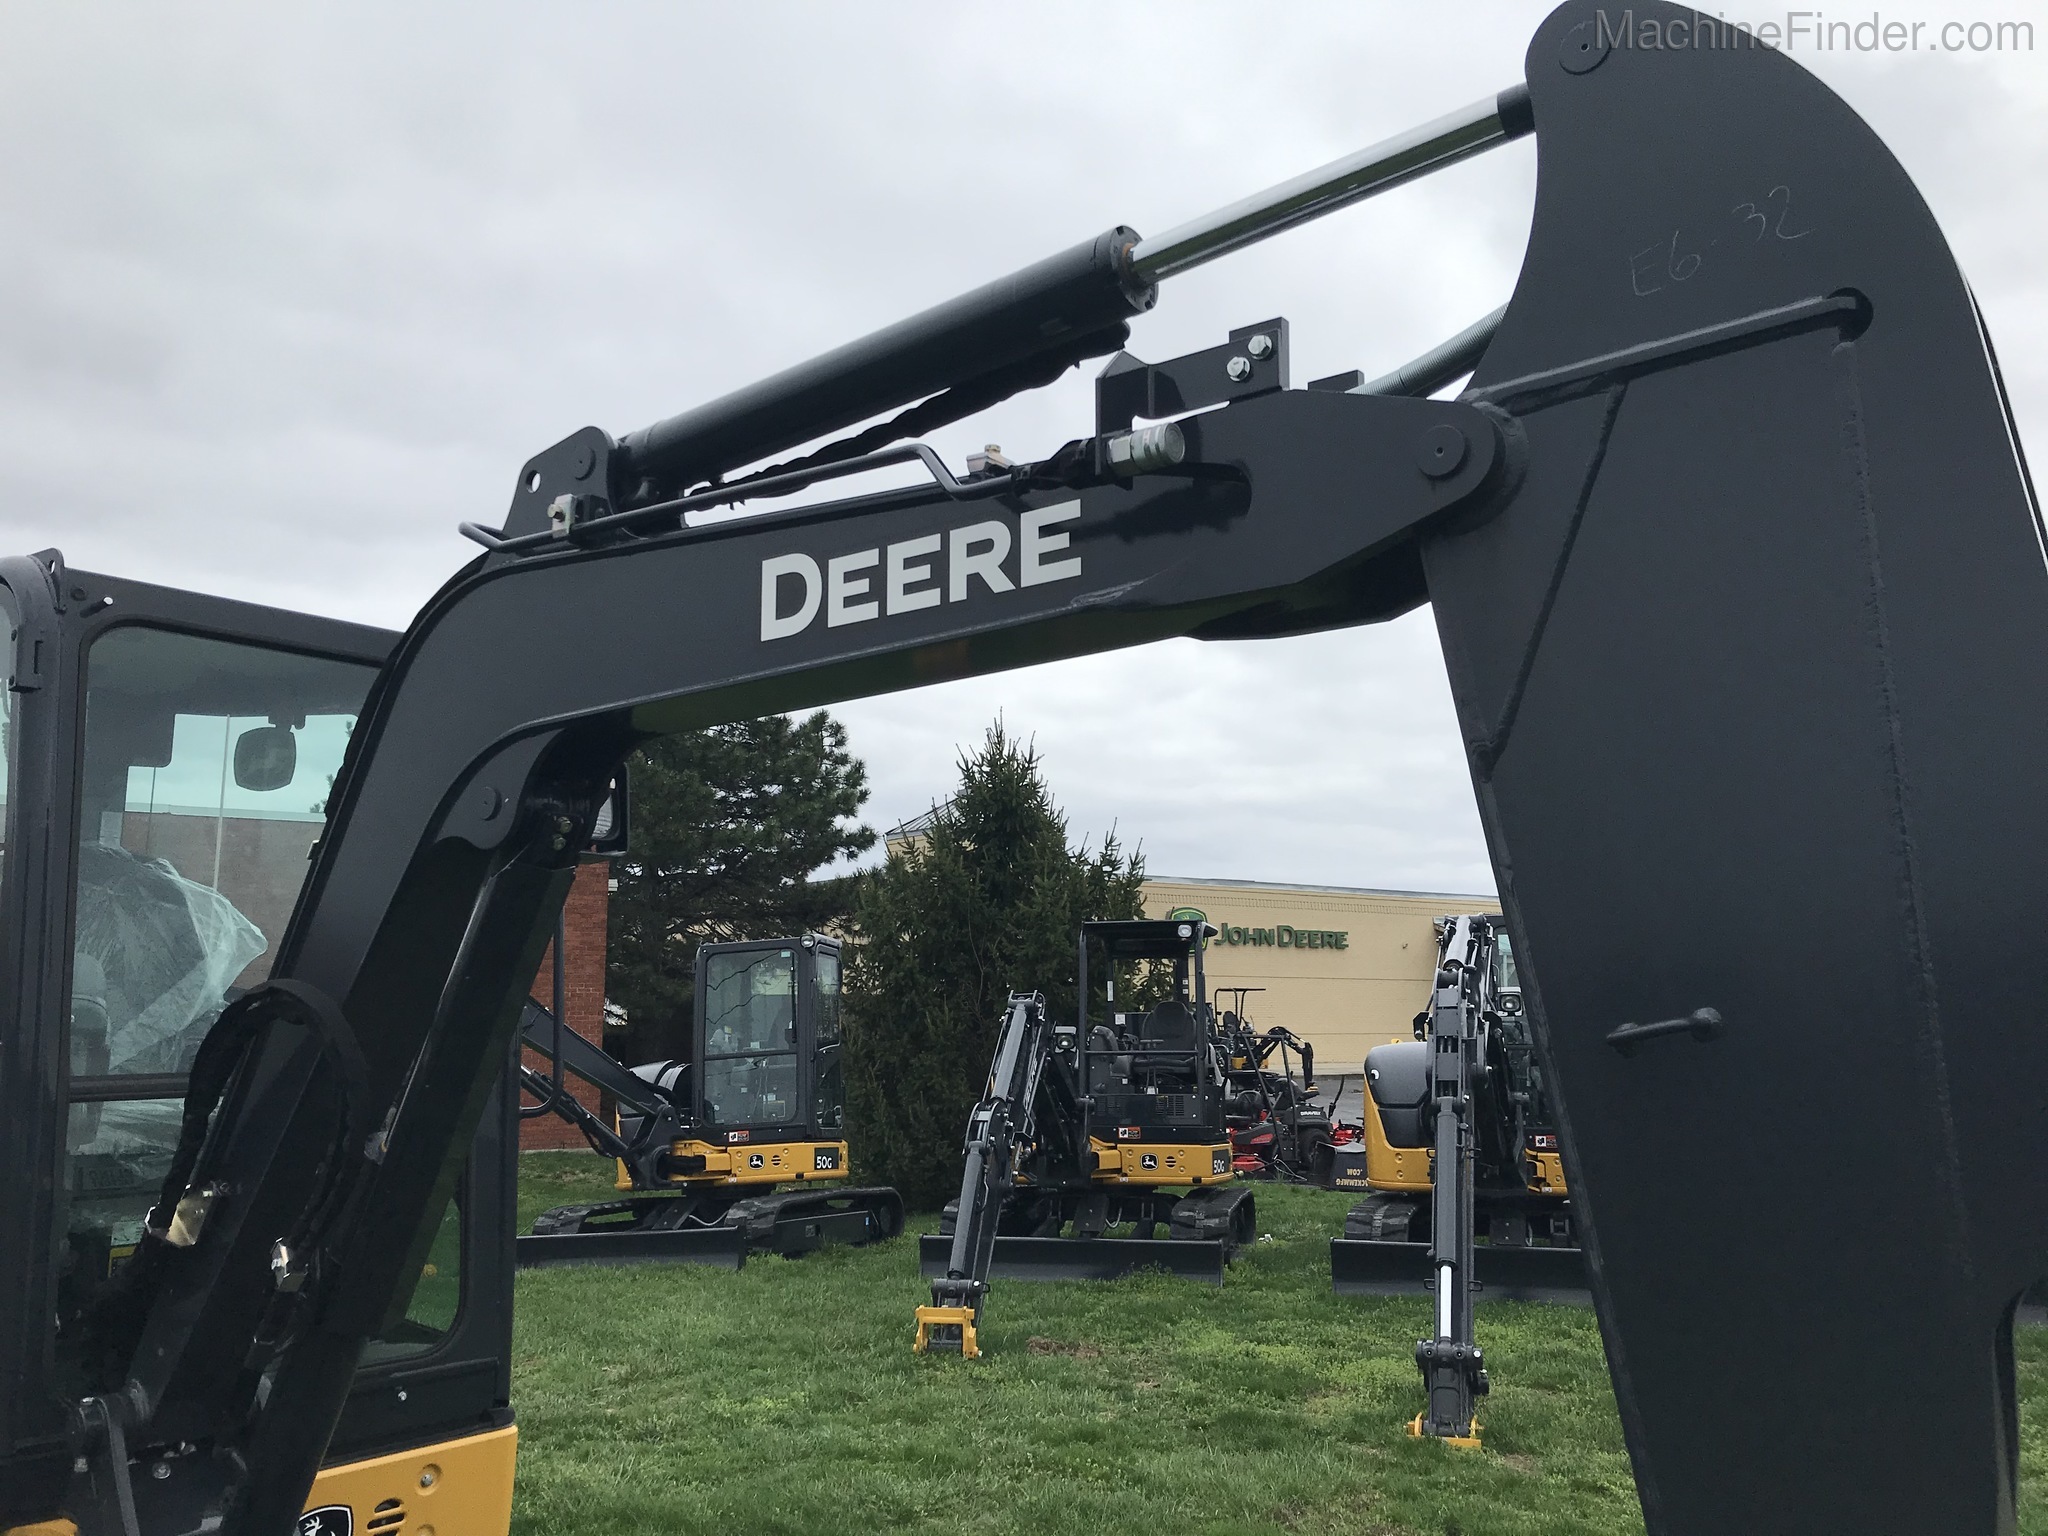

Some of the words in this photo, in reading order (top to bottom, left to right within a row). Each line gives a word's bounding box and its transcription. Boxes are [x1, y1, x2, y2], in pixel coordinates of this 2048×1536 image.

[761, 498, 1082, 642] DEERE
[1214, 922, 1275, 947] JOHN
[1276, 924, 1349, 950] DEERE
[816, 1155, 833, 1169] 50G
[1213, 1159, 1225, 1174] 50G
